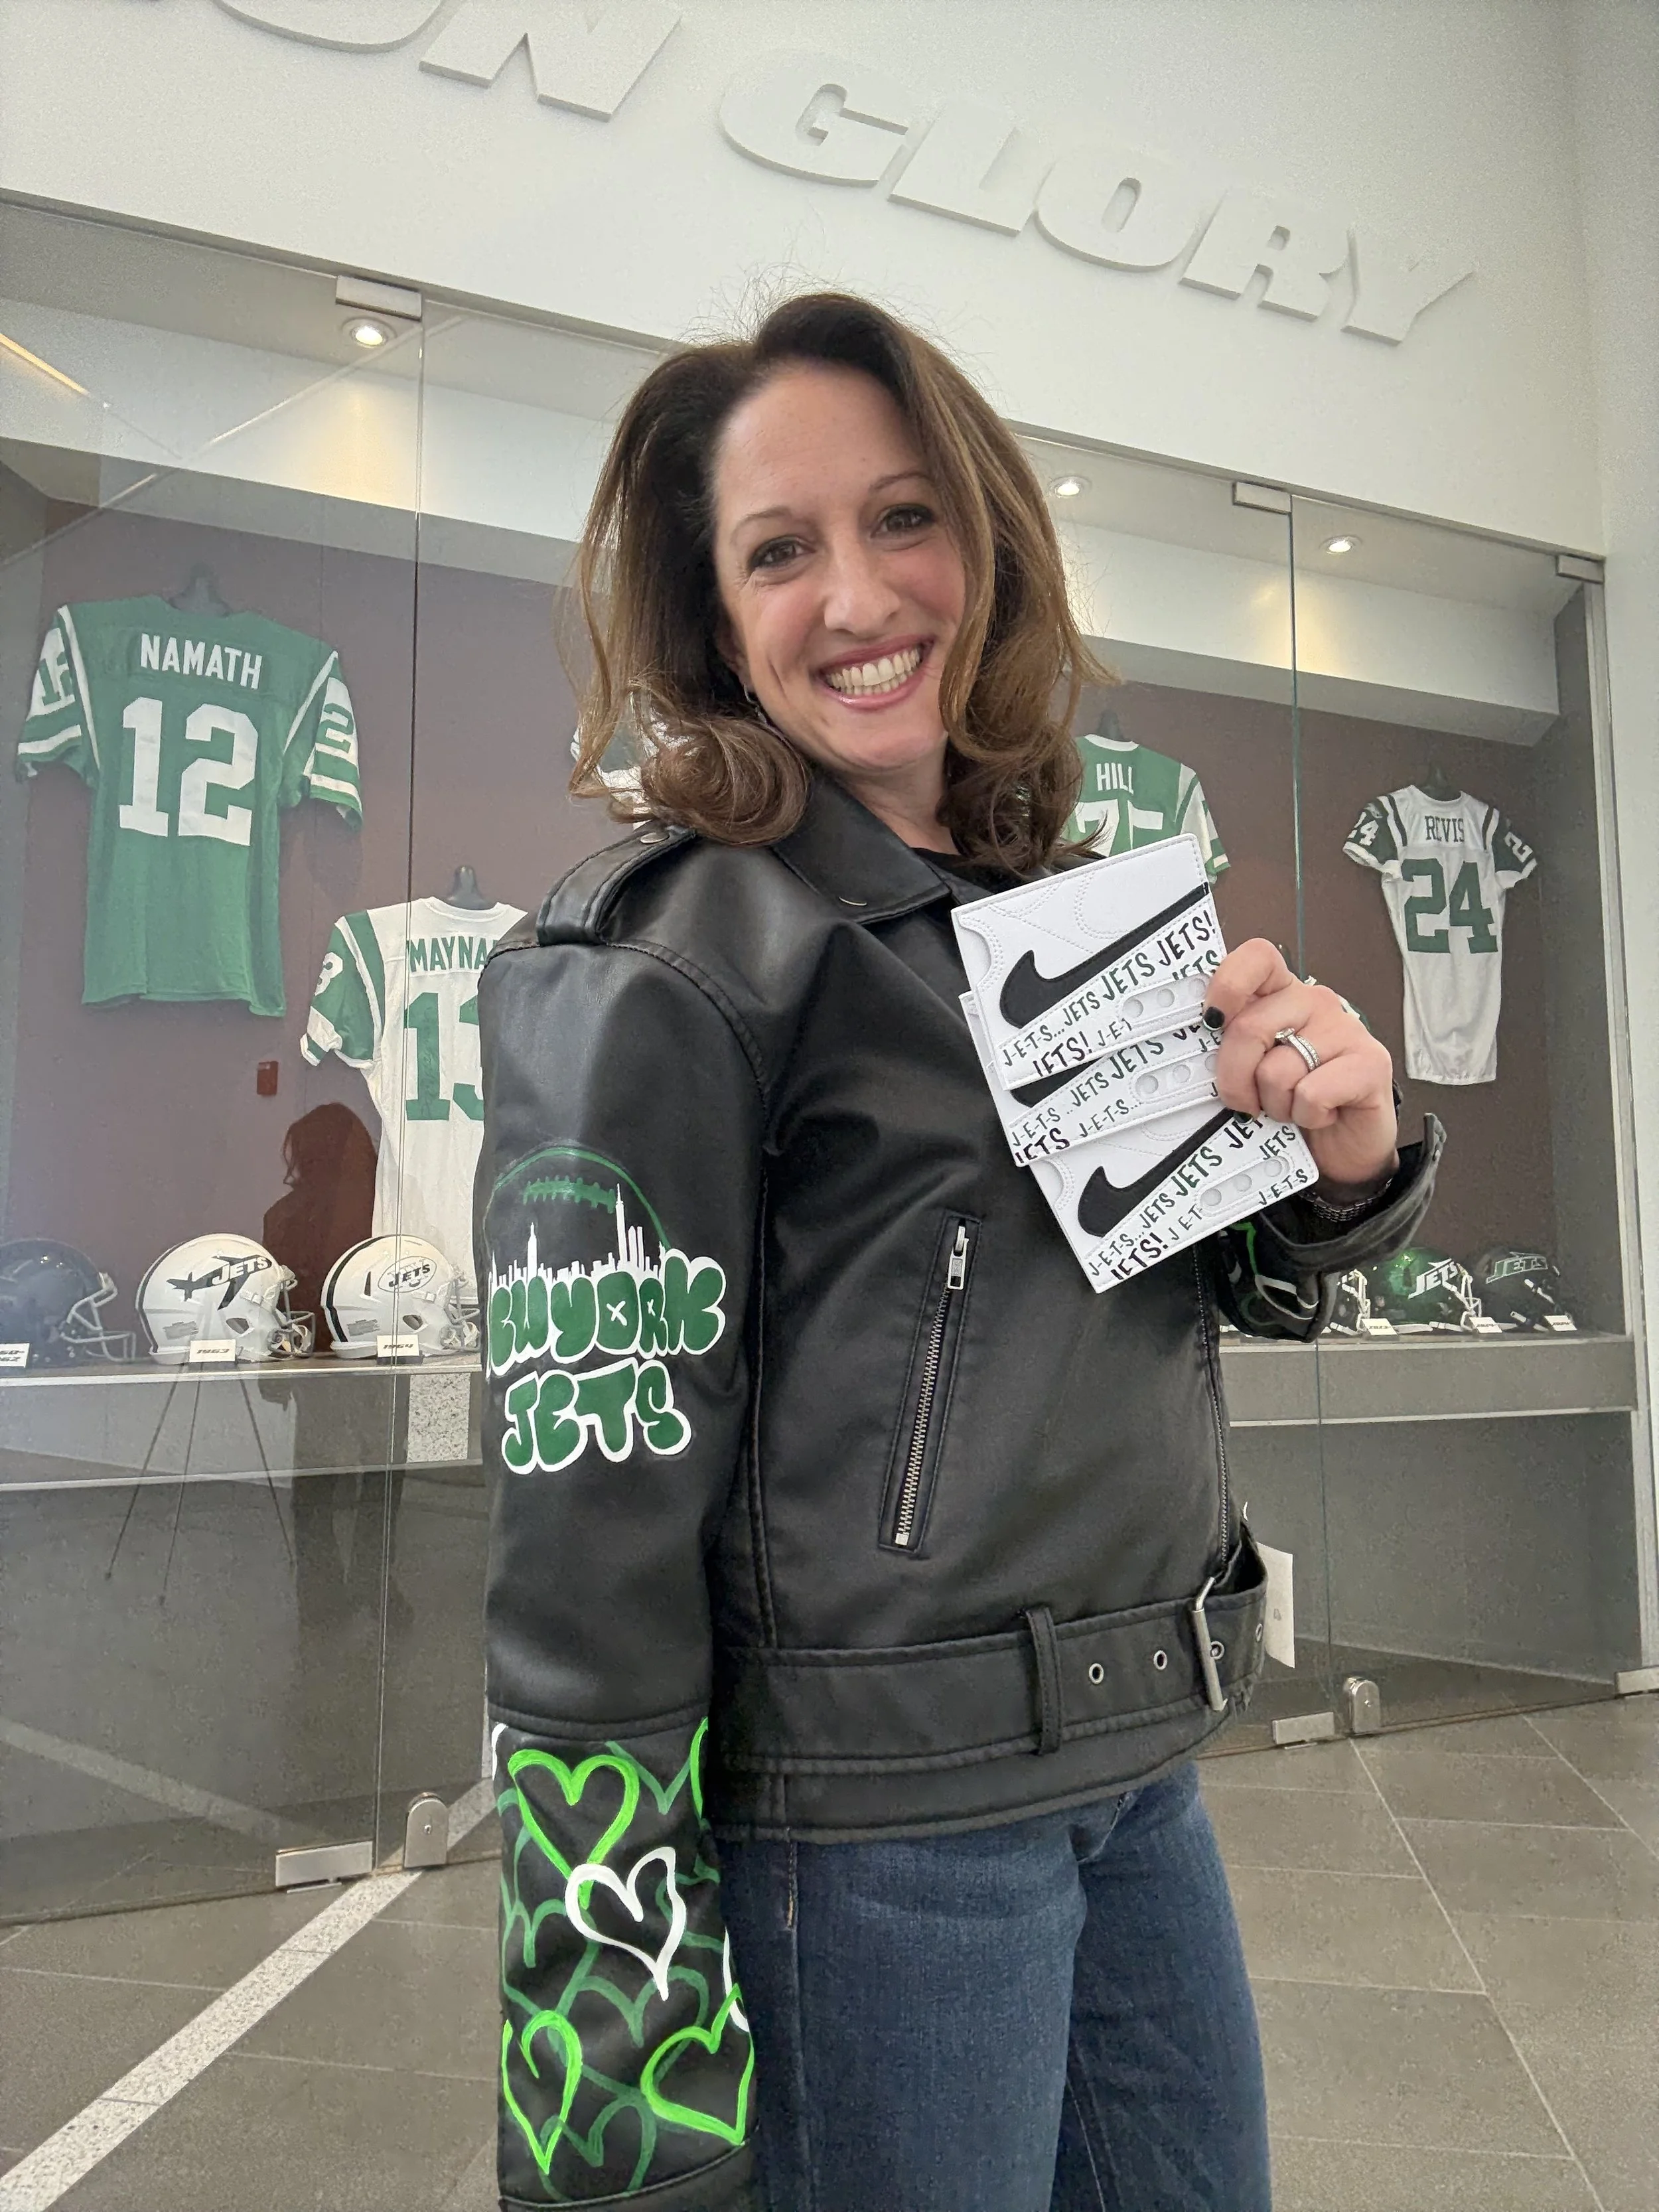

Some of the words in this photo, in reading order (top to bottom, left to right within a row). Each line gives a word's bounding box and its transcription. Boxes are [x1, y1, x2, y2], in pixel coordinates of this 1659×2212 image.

[718, 50, 1475, 346] GLORY
[141, 633, 263, 690] NAMATH
[119, 696, 258, 846] 12
[1096, 763, 1134, 795] HILL
[1400, 857, 1498, 954] 24
[406, 935, 498, 972] MAYNA
[1062, 991, 1100, 1026] JETS
[1101, 952, 1156, 1001] JETS
[1157, 910, 1216, 966] JETS!
[1070, 1072, 1110, 1107] JETS
[1259, 1126, 1296, 1160] JETS
[1139, 1193, 1175, 1229] JETS
[1170, 1145, 1223, 1197] JETS
[212, 1256, 269, 1285] JETS
[388, 1264, 431, 1288] JETS
[1407, 1258, 1459, 1299] JETS
[549, 1248, 726, 1364] YORK
[501, 1357, 691, 1475] JETS
